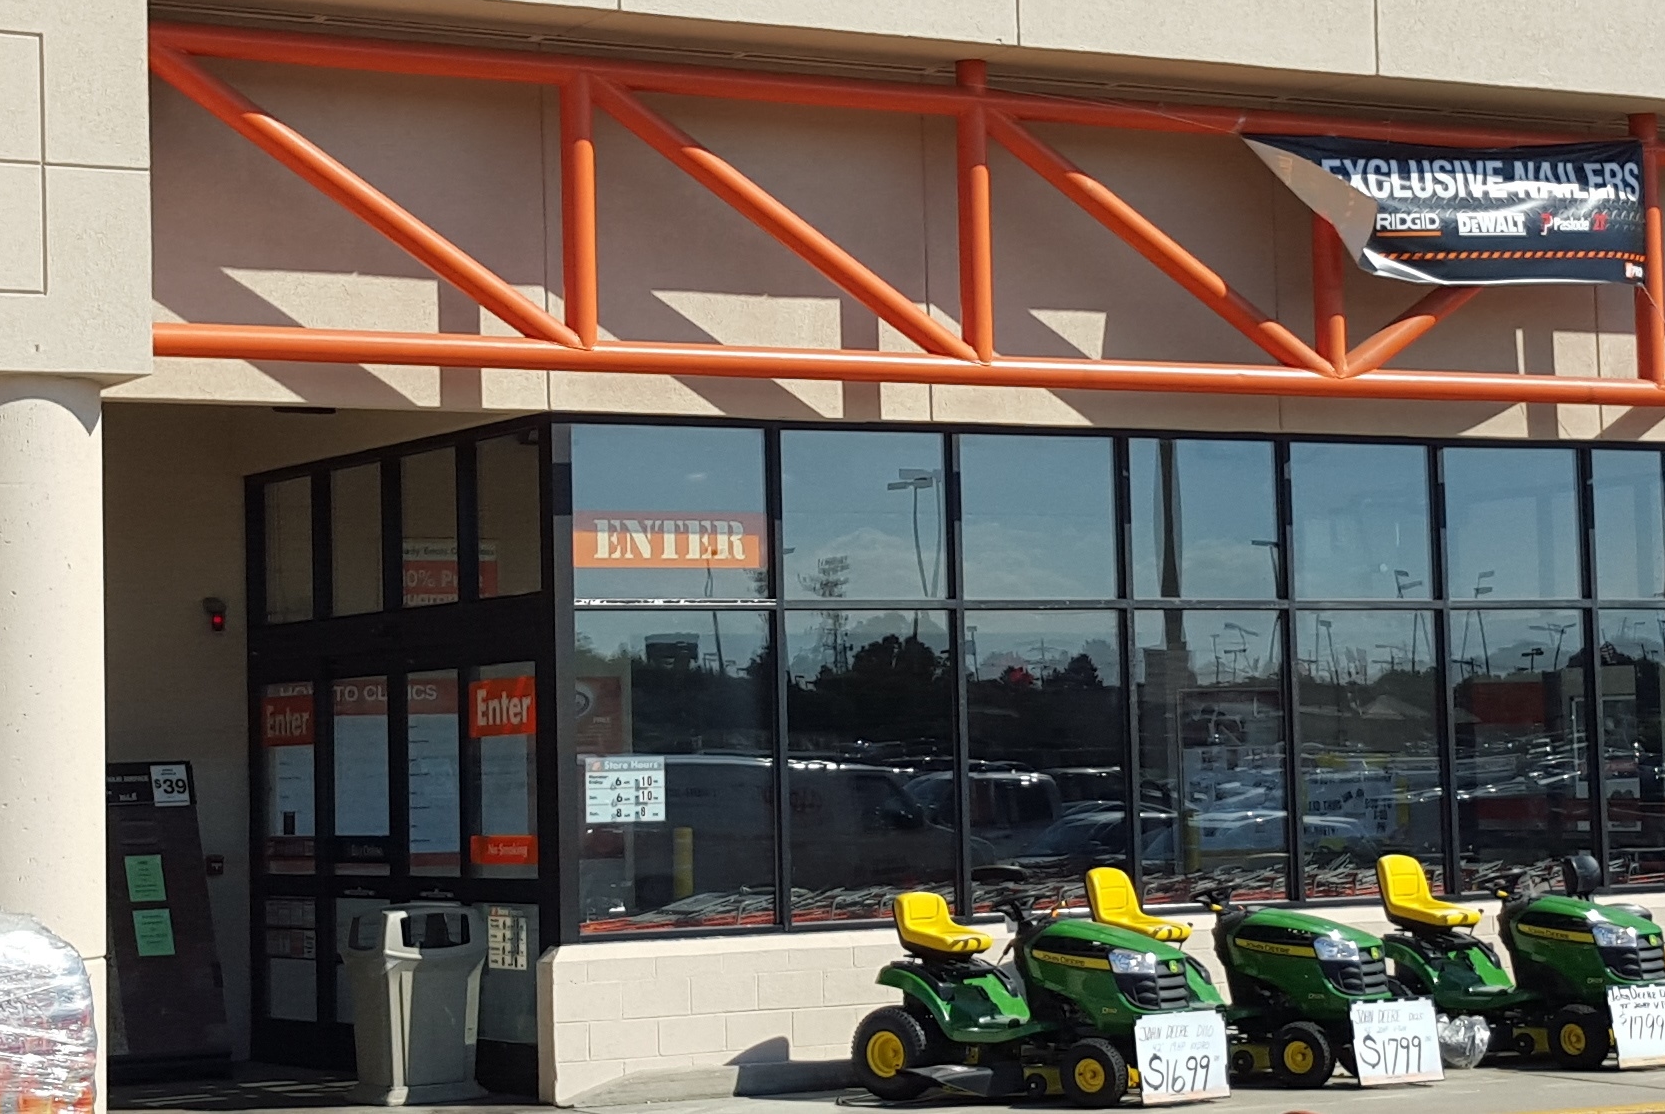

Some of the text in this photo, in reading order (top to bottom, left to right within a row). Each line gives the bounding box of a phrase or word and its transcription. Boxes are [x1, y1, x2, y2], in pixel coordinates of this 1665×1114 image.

[1321, 158, 1640, 201] EXCLUSIVE NAILERS
[1376, 213, 1440, 230] RIDGID
[1553, 216, 1590, 231] Paslode
[593, 519, 746, 560] ENTER
[335, 687, 358, 701] TO
[363, 685, 438, 701] CLICS
[476, 688, 532, 726] Enter
[267, 705, 310, 738] Enter
[604, 760, 659, 770] Store Hours
[154, 778, 187, 794] $39
[615, 777, 622, 786] 6
[641, 775, 653, 787] 10
[616, 793, 623, 803] 6
[641, 790, 653, 801] 10
[616, 808, 622, 817] 8
[487, 843, 528, 858] No Smoking
[1265, 943, 1290, 953] DEERE
[1060, 956, 1086, 967] DEERE
[1354, 1009, 1374, 1024] JOHN
[1377, 1008, 1402, 1024] DEERE
[1139, 1026, 1162, 1042] JOHN
[1166, 1024, 1189, 1040] DEERE
[1359, 1033, 1421, 1075] $1799
[1144, 1053, 1211, 1093] $1699
